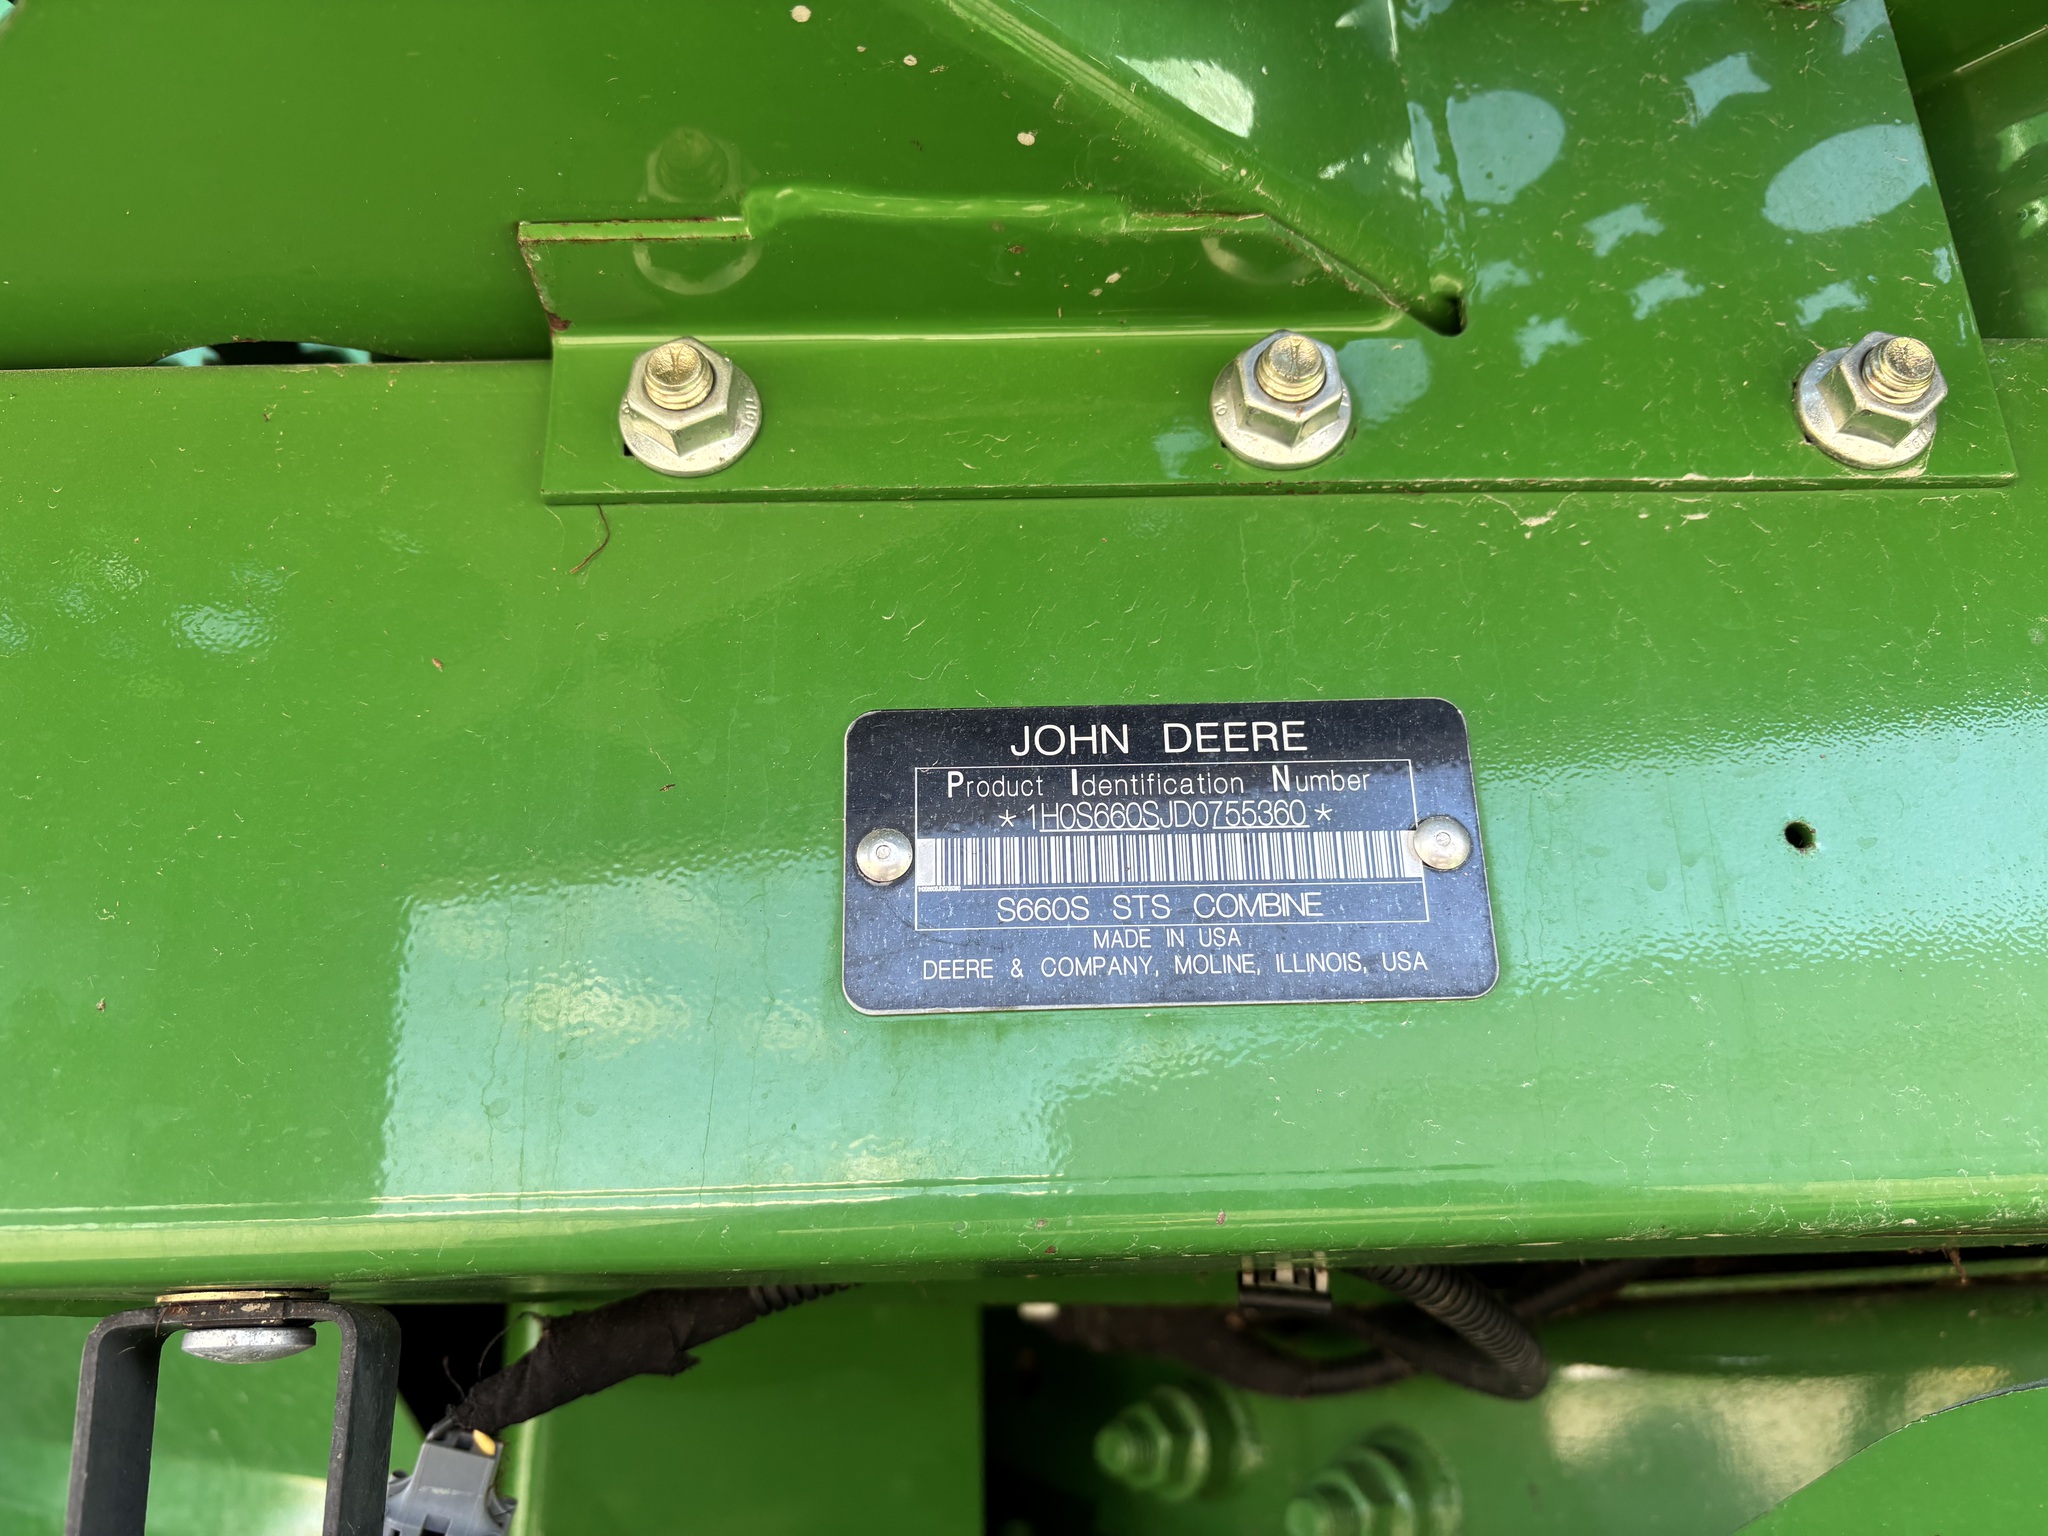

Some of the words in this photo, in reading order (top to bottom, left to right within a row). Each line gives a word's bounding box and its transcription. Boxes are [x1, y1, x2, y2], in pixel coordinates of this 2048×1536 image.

[1010, 723, 1128, 757] JOHN
[1164, 721, 1307, 753] DEERE
[948, 770, 1044, 797] Product
[1071, 769, 1244, 795] Identification
[1272, 765, 1370, 792] Number
[998, 895, 1089, 922] S660S
[1114, 894, 1171, 920] STS
[1194, 892, 1323, 918] COMBINE
[1093, 929, 1151, 949] MADE
[1166, 928, 1184, 947] IN
[1198, 927, 1241, 947] USA
[923, 958, 993, 980] DEERE
[1010, 957, 1024, 978] &
[1041, 956, 1160, 977] COMPANY,
[1175, 954, 1261, 976] MOLINE,
[1276, 952, 1367, 974] ILLINOIS,
[1382, 951, 1427, 971] USA
